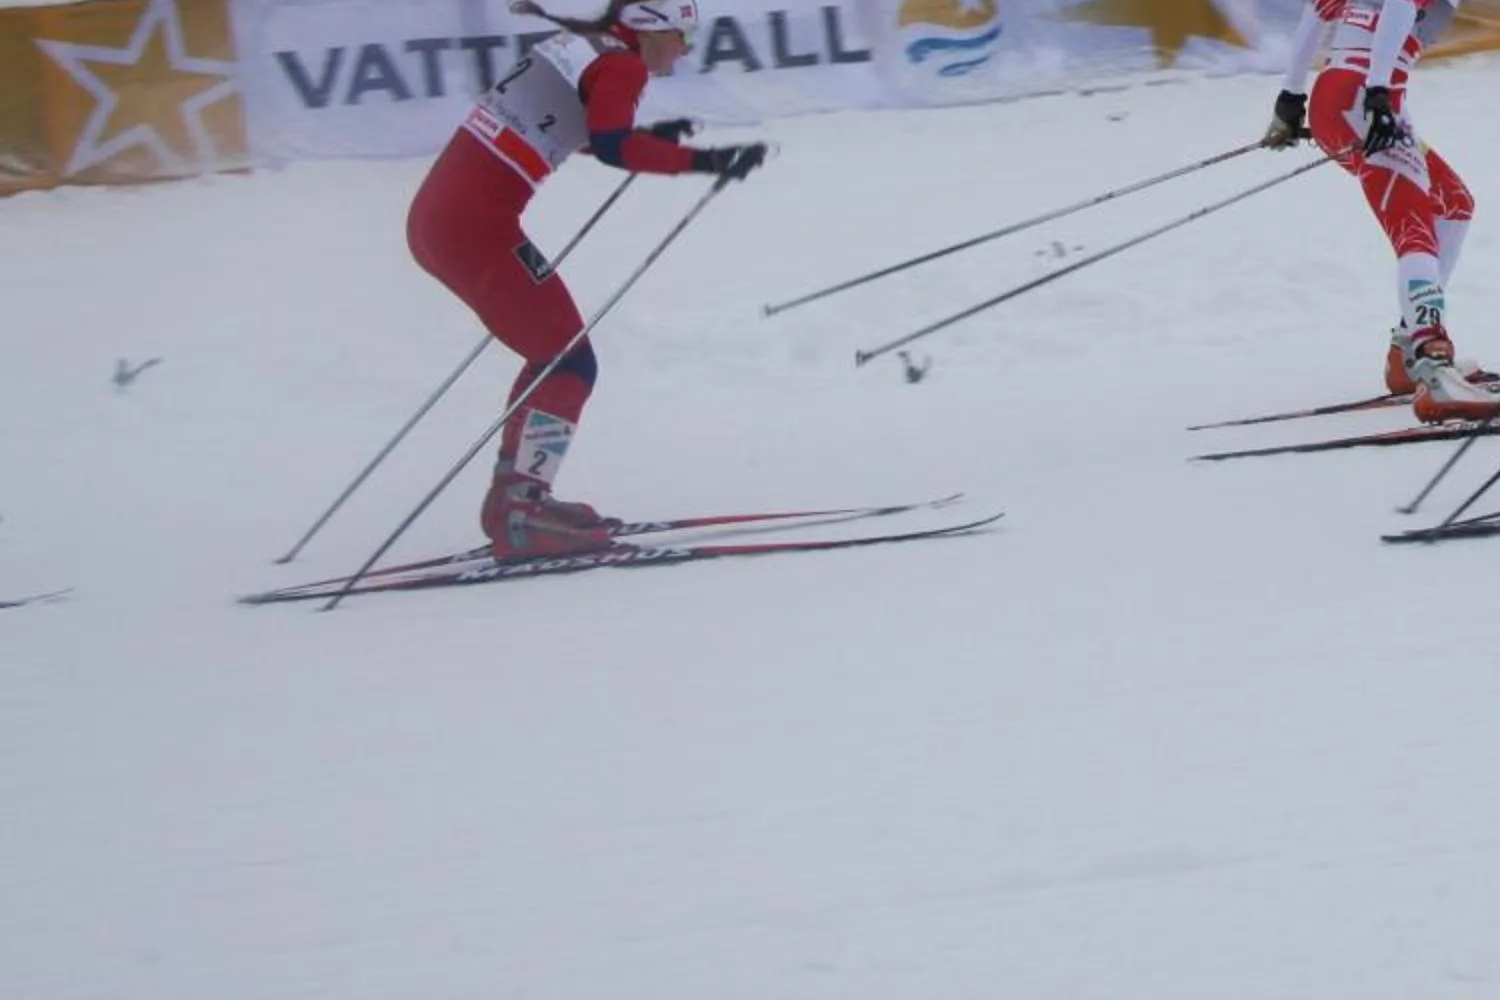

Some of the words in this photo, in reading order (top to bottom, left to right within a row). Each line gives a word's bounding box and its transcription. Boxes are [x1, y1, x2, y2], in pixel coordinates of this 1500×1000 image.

[274, 4, 873, 109] VATTALL
[496, 58, 534, 94] 2
[528, 450, 548, 476] 2
